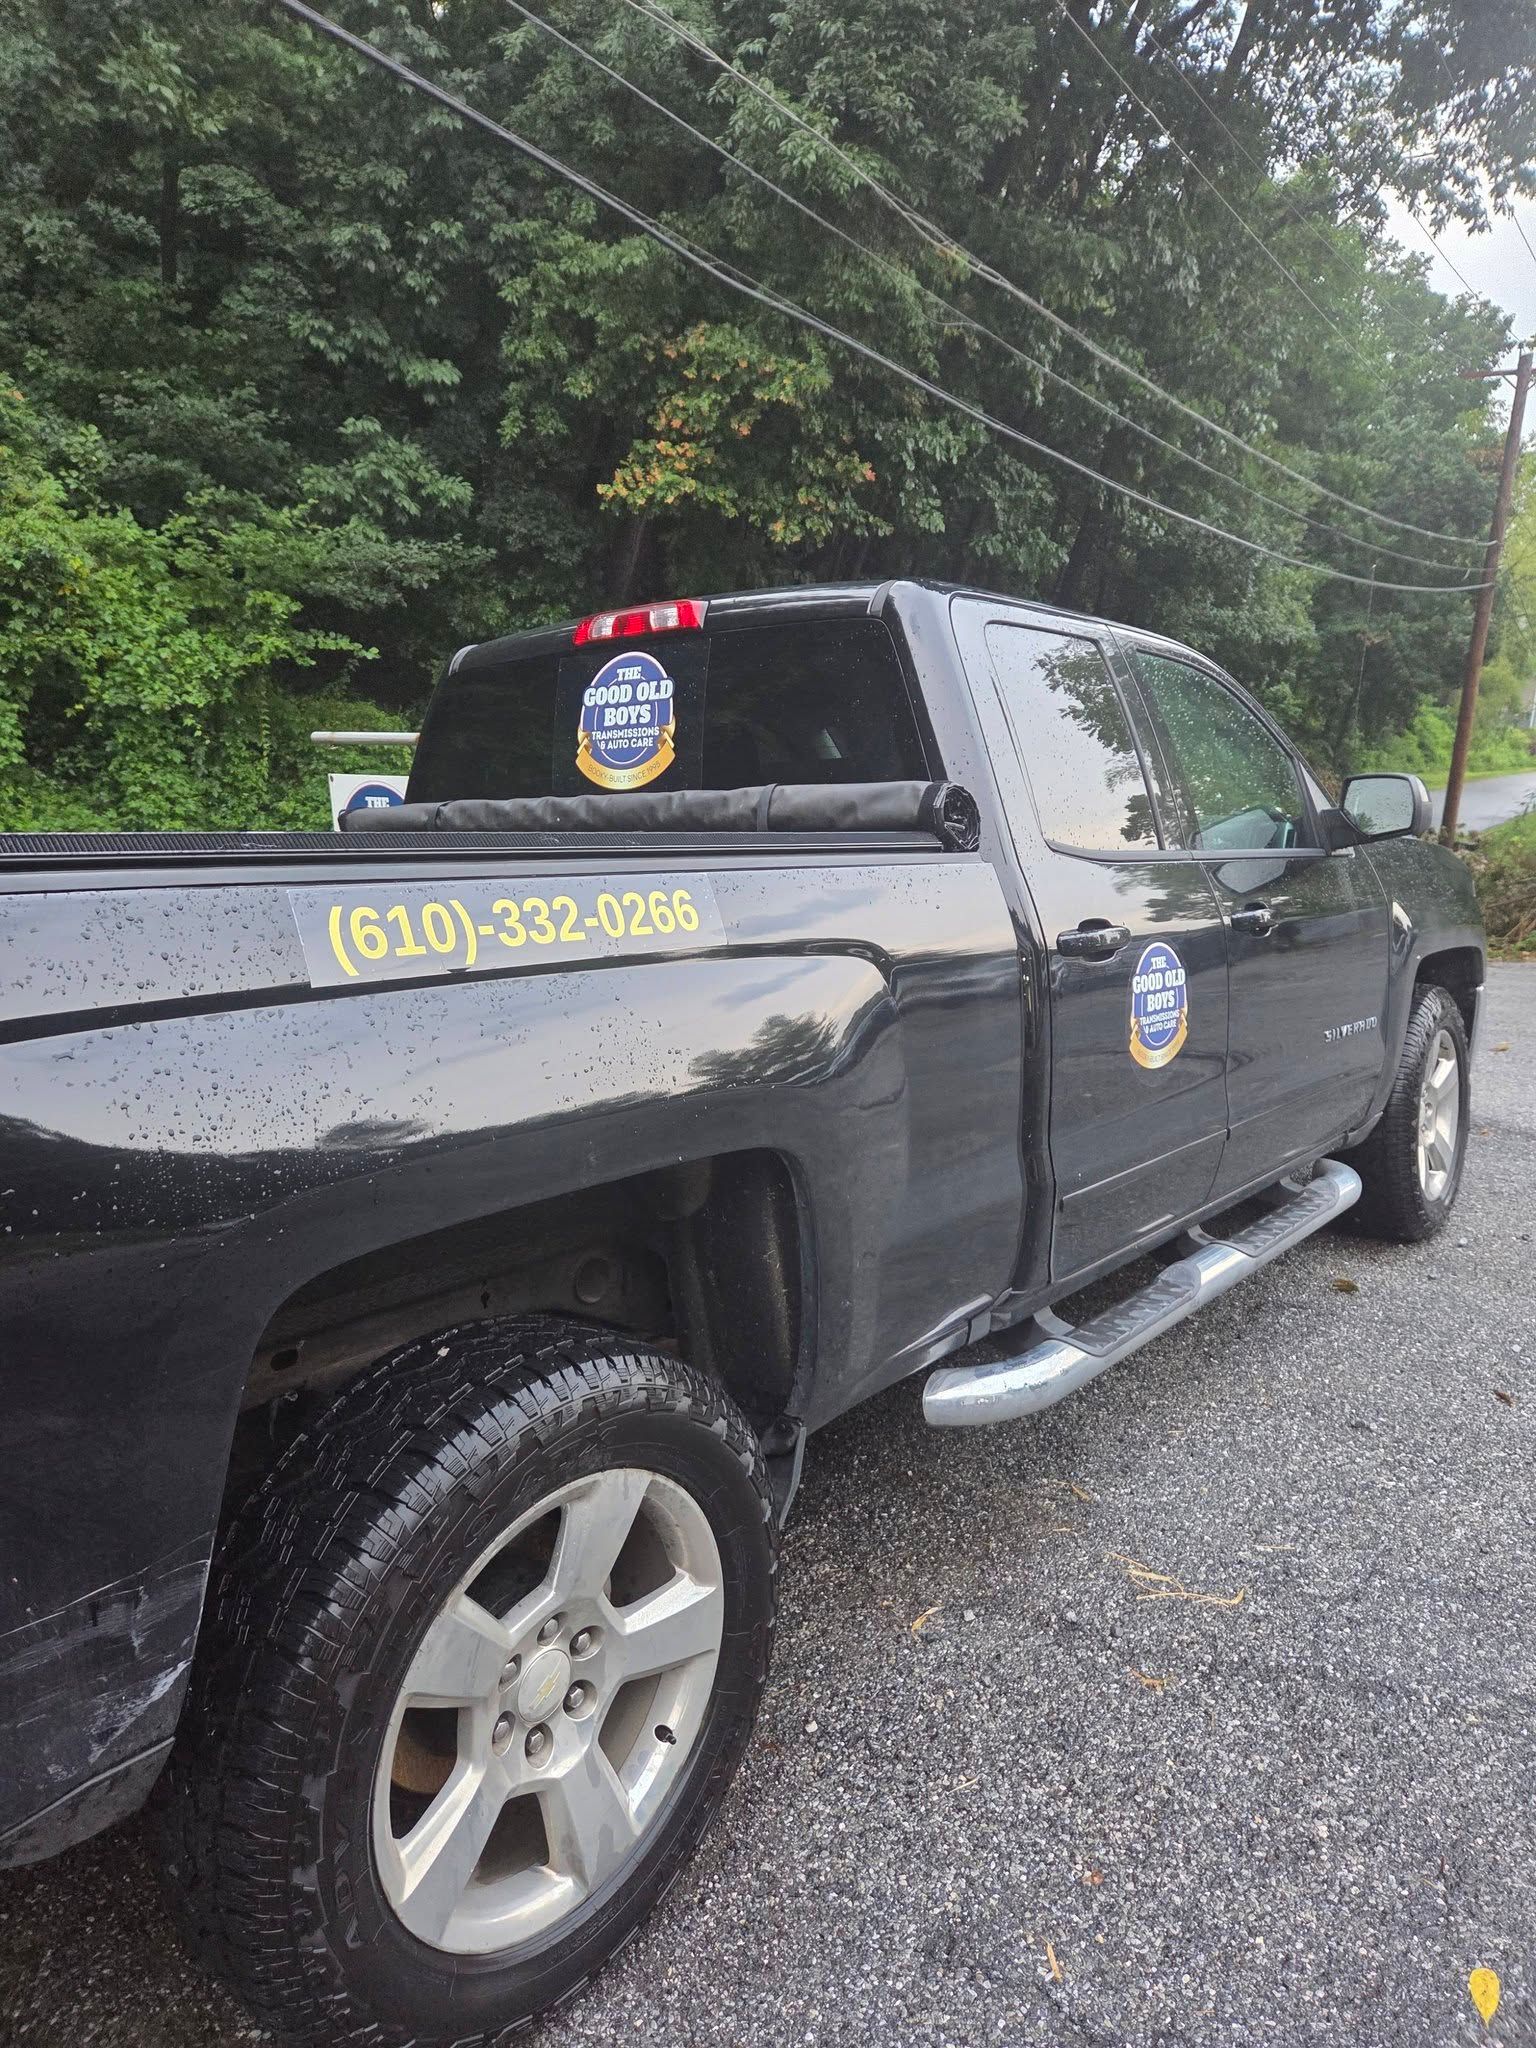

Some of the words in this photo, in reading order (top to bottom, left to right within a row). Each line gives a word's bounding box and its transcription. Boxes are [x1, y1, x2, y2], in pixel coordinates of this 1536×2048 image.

[617, 666, 642, 681] THE
[584, 684, 633, 707] GOOD
[636, 679, 674, 701] OLD
[604, 704, 651, 727] BOYS
[592, 727, 660, 741] TRANSMISSIONS
[607, 738, 630, 749] AUTO
[631, 737, 654, 748] CARE
[627, 769, 647, 783] SINCE
[365, 796, 390, 808] THE
[328, 889, 700, 977] (610)-332-0266
[1151, 956, 1167, 969] THE
[1132, 973, 1163, 994] GOOD
[1164, 968, 1185, 989] OLD
[1146, 990, 1175, 1013] BOYS
[1140, 1009, 1180, 1026] TRANSMISSIONS
[1149, 1022, 1163, 1034] AUTO
[1163, 1019, 1177, 1031] CARE
[1323, 1016, 1378, 1042] SILVERADO
